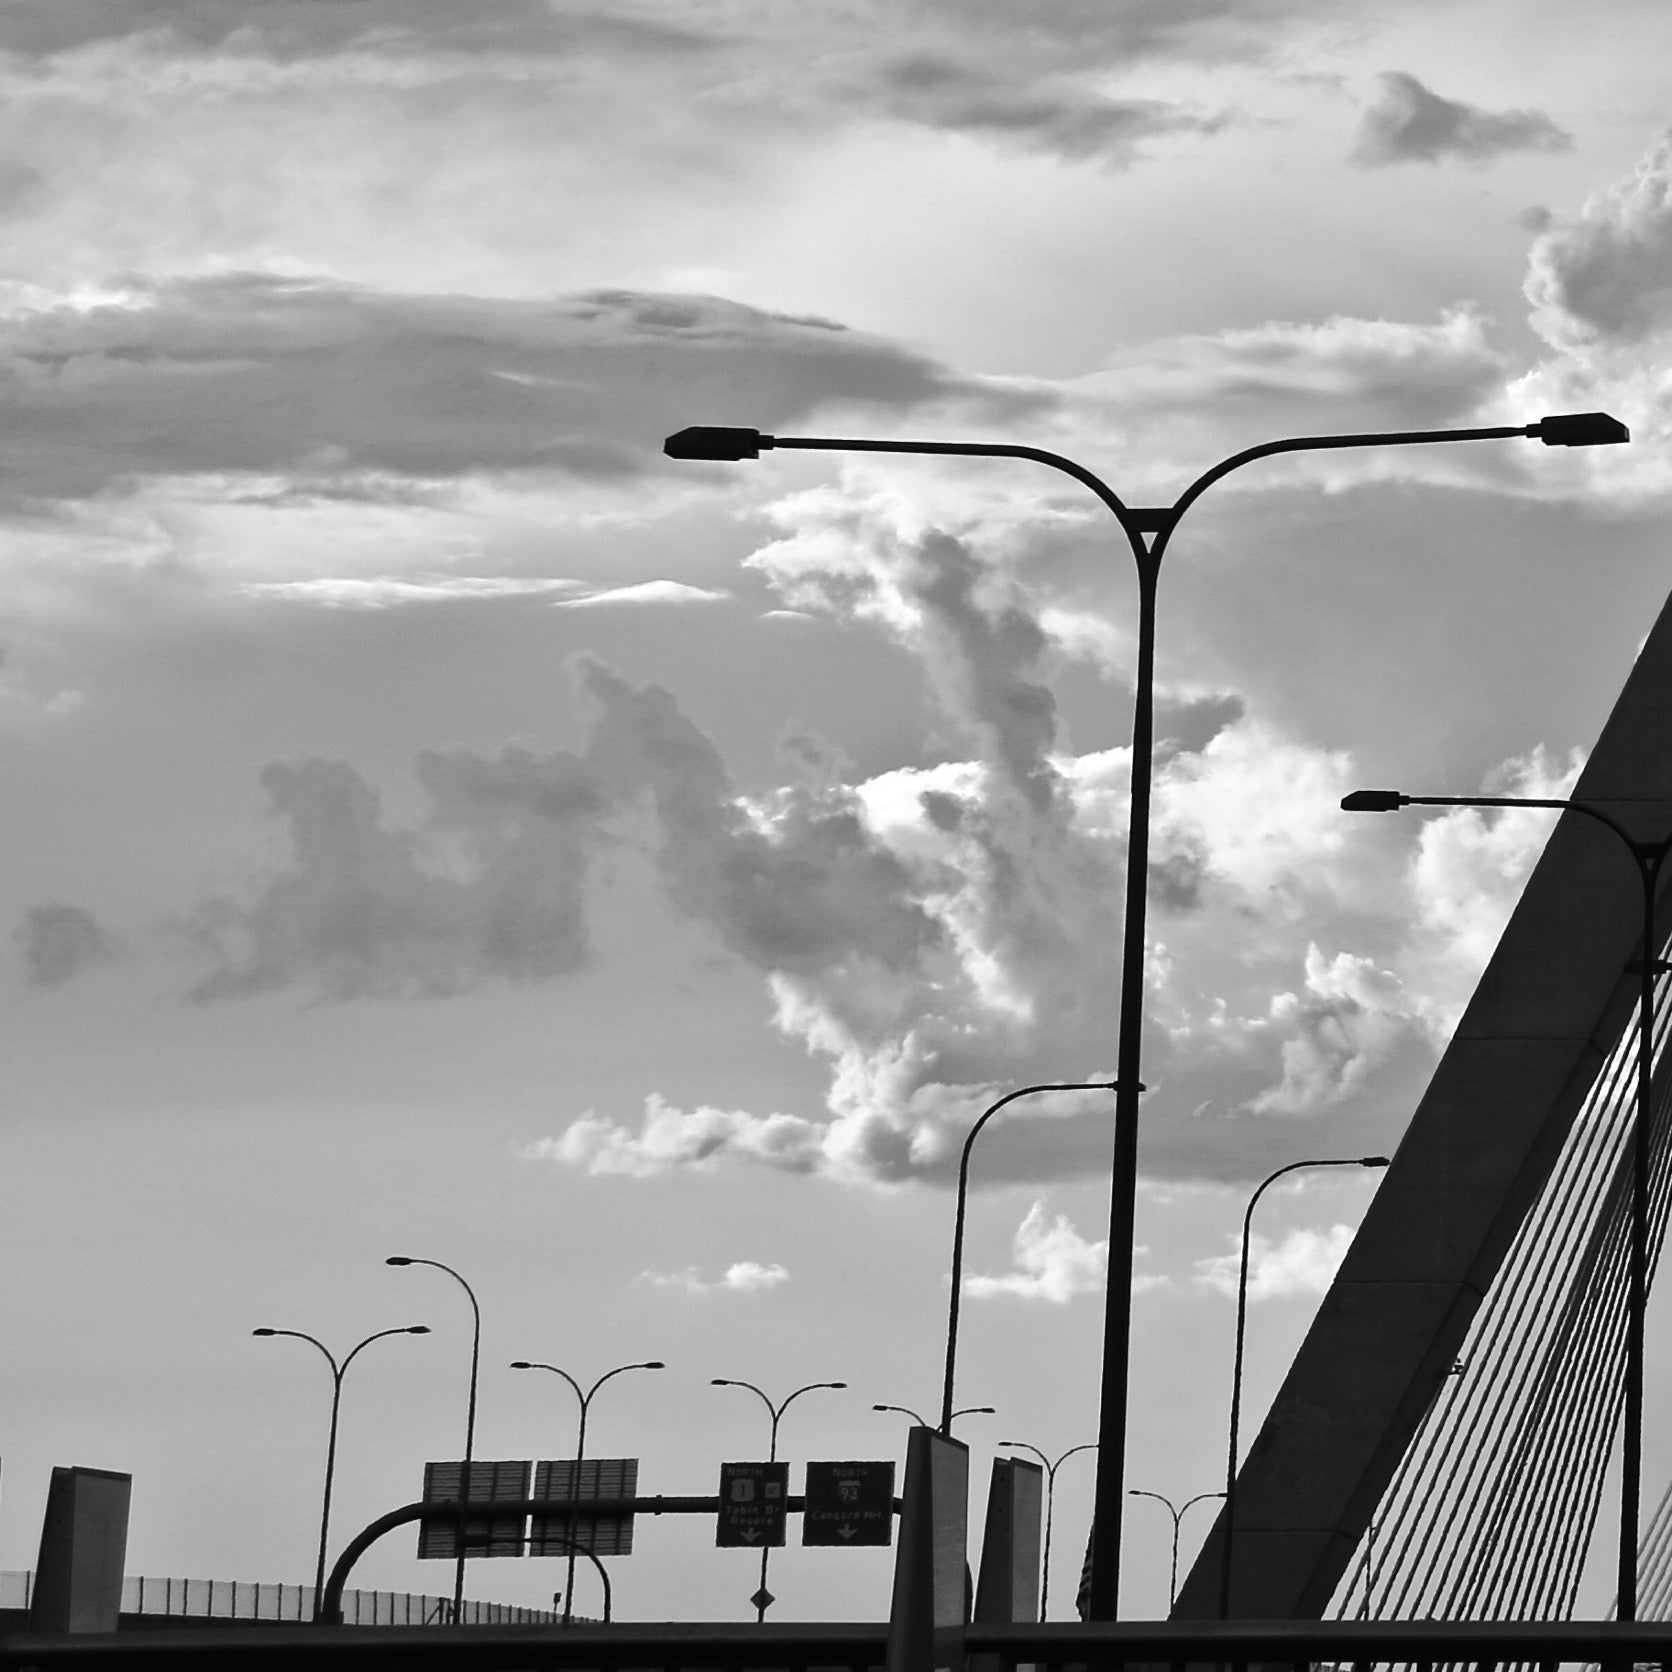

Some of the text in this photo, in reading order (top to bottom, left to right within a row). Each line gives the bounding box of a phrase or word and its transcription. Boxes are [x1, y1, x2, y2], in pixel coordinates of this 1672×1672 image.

[726, 1467, 764, 1477] NORTH
[832, 1467, 868, 1477] NORTH
[840, 1487, 858, 1500] 93
